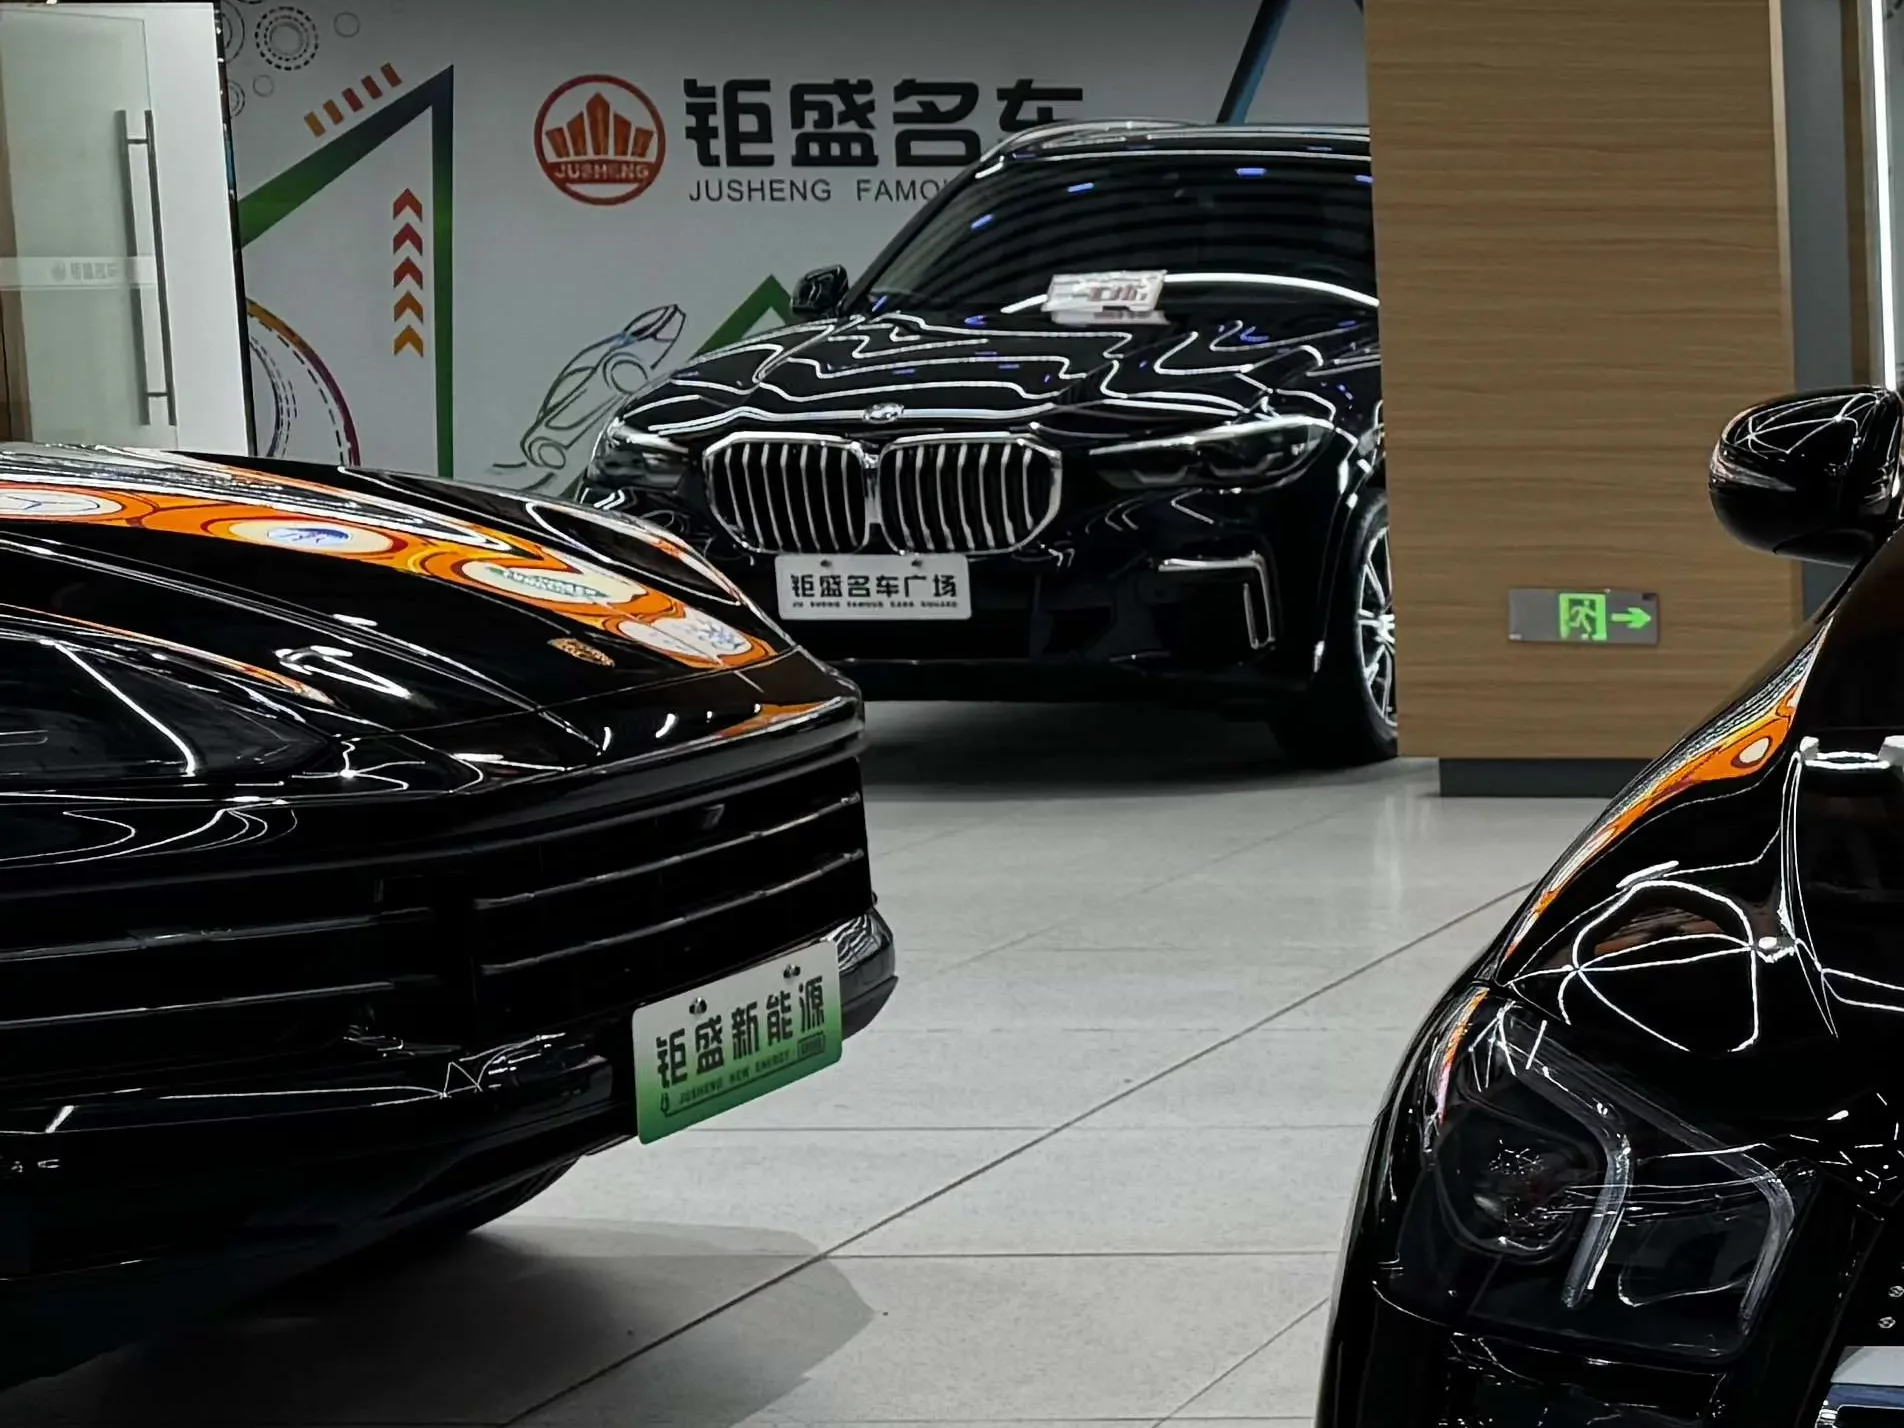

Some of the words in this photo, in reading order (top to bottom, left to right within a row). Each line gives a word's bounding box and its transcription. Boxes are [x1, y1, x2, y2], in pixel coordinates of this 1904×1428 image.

[683, 78, 1083, 168] 钜盛名车
[554, 163, 648, 180] JUSHENG
[688, 179, 832, 202] JUSHENG
[857, 178, 952, 201] FAMO
[791, 574, 957, 598] 钜盛名车广场
[656, 975, 825, 1089] 钜盛新能源
